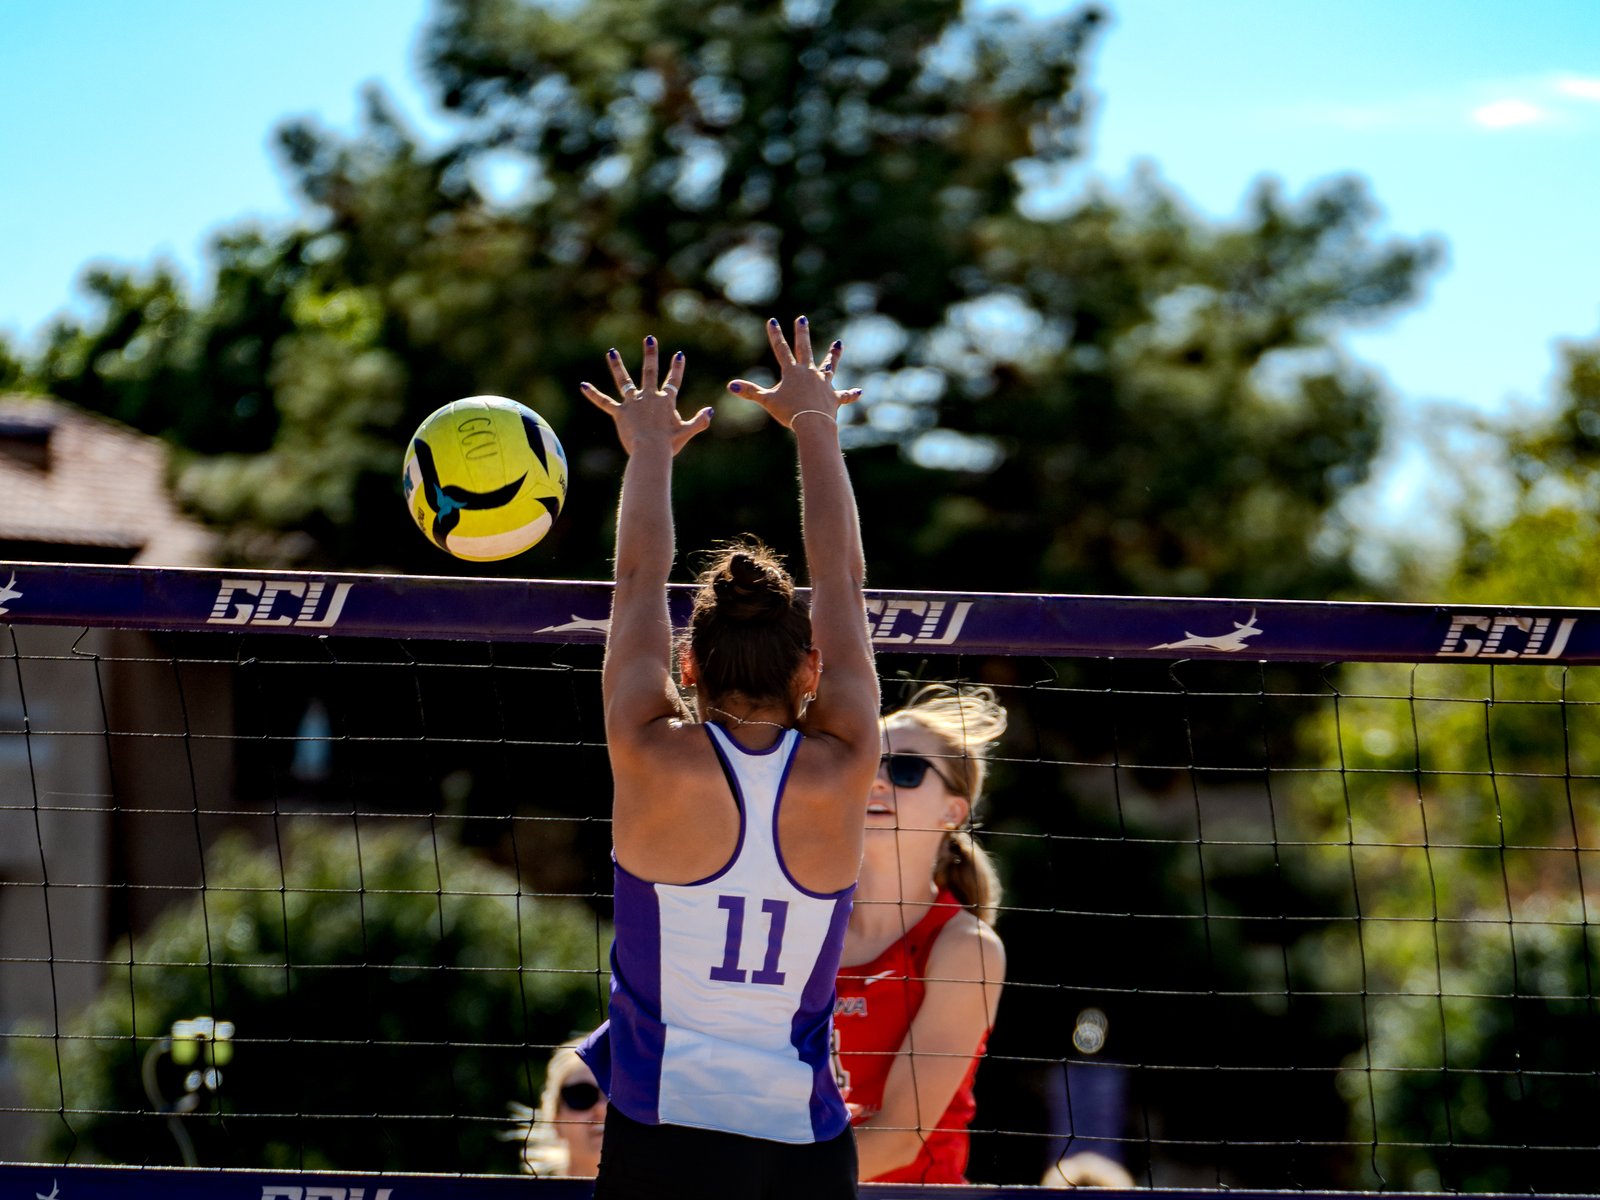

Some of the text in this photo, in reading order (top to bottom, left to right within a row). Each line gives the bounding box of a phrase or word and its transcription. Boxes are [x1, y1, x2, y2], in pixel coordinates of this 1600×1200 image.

[458, 417, 498, 461] GCU
[206, 579, 354, 628] GCU
[1435, 615, 1578, 659] GCU
[709, 894, 789, 986] 11
